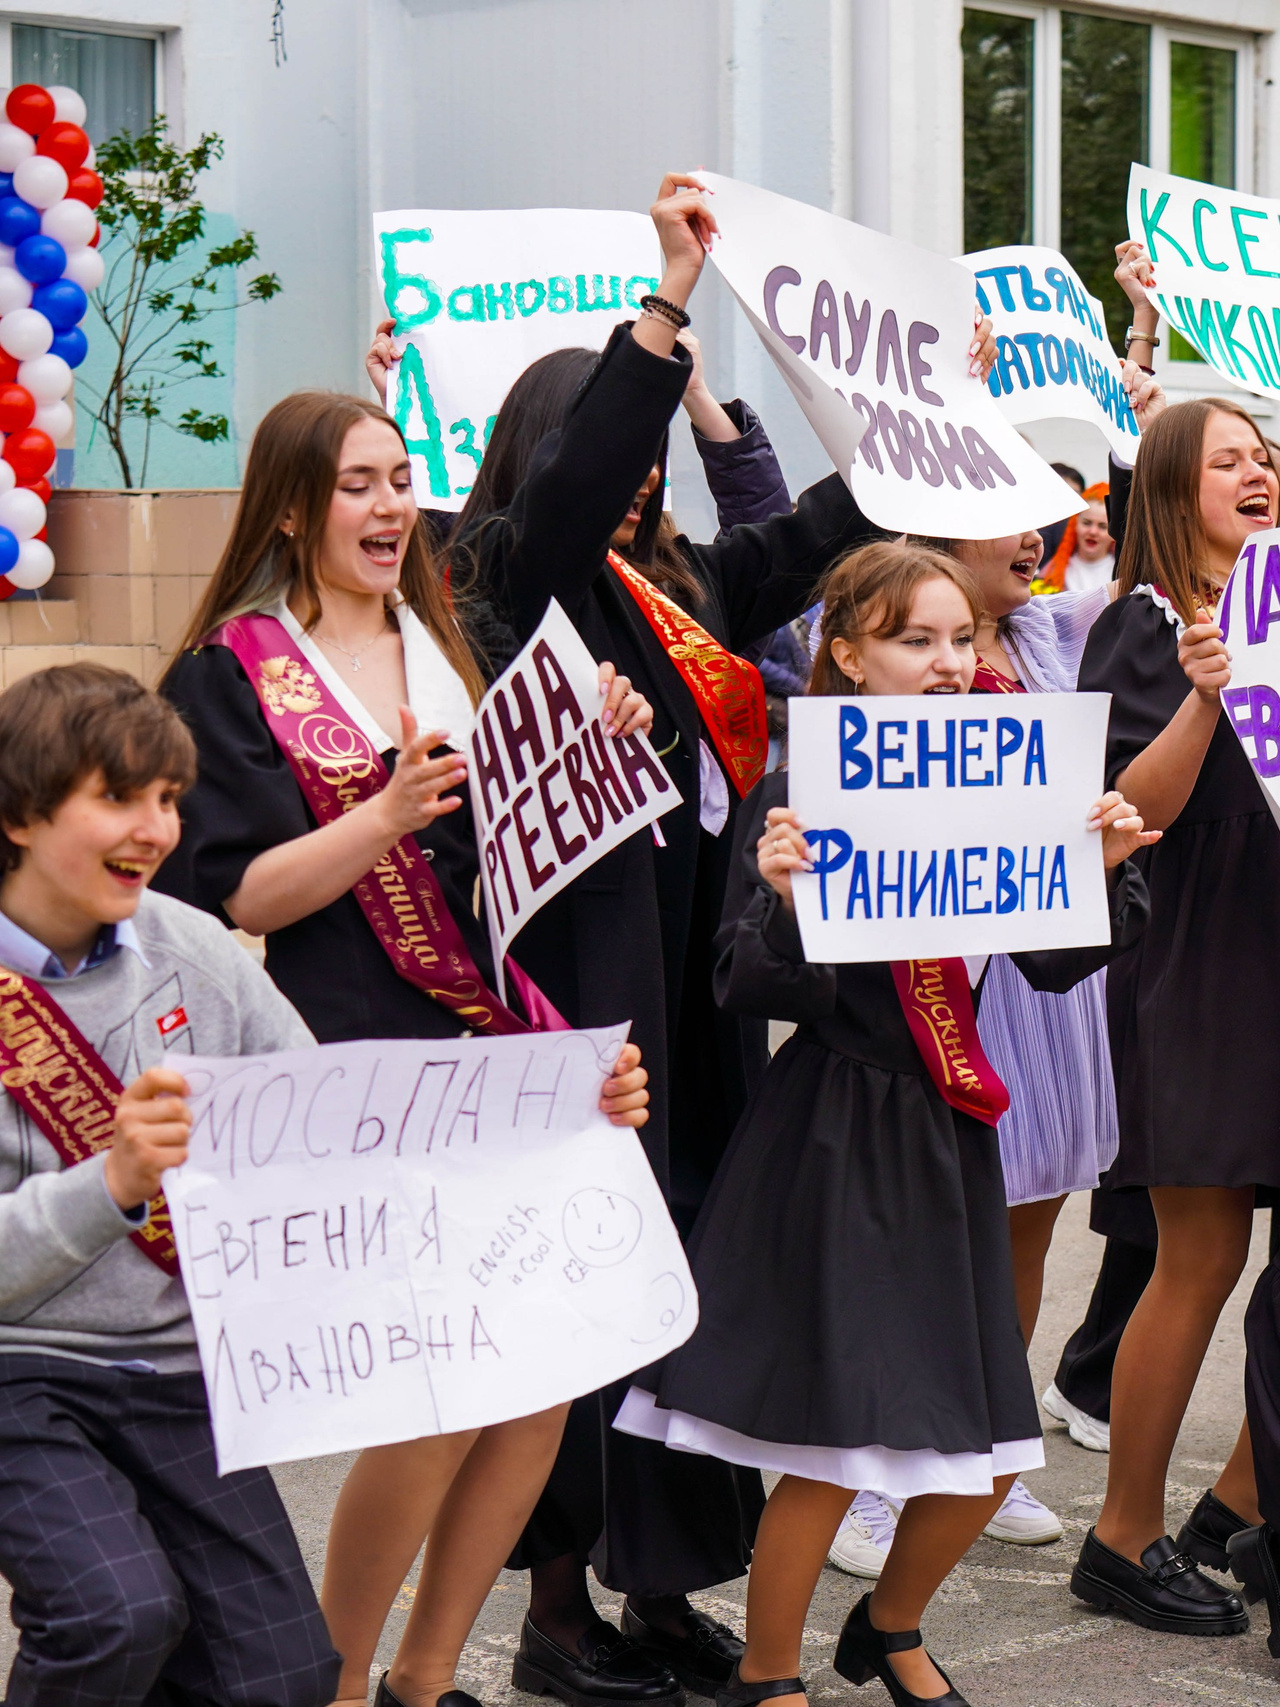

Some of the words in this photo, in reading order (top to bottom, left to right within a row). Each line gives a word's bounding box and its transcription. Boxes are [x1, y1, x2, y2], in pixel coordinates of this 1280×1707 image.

[763, 265, 945, 407] САУЛЕ
[834, 386, 1017, 491] РОВНА
[472, 638, 585, 825] ННА
[839, 705, 1047, 790] ВЕНЕРА
[485, 718, 670, 937] РГЕЕВНА
[802, 828, 1070, 921] ФАНИЛЕВНА
[914, 958, 983, 1091] пускник
[185, 1184, 441, 1300] ЕВГЕНИЯ
